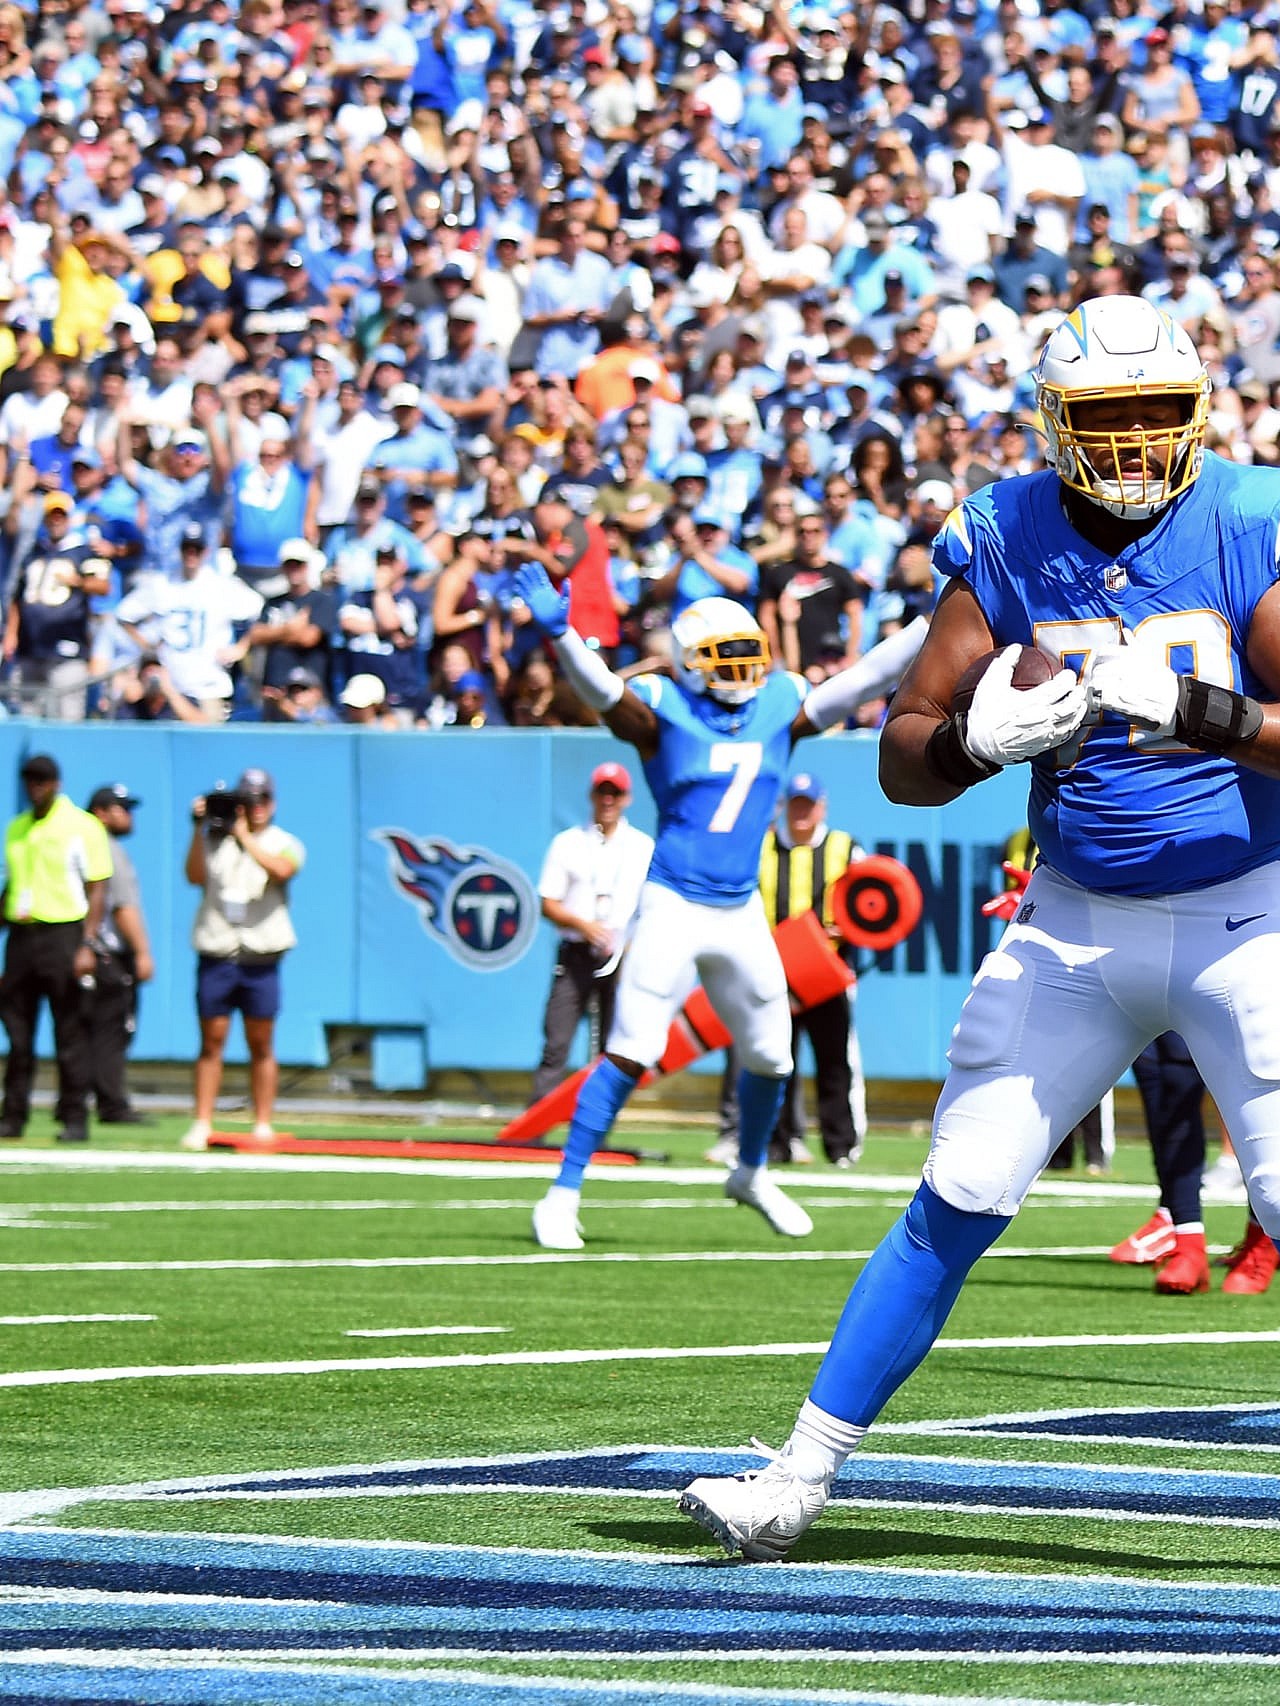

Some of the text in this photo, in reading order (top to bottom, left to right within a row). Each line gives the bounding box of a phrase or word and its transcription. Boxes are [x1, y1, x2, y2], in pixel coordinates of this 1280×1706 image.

[169, 608, 206, 651] 31
[707, 741, 763, 833] 7
[457, 893, 517, 949] T
